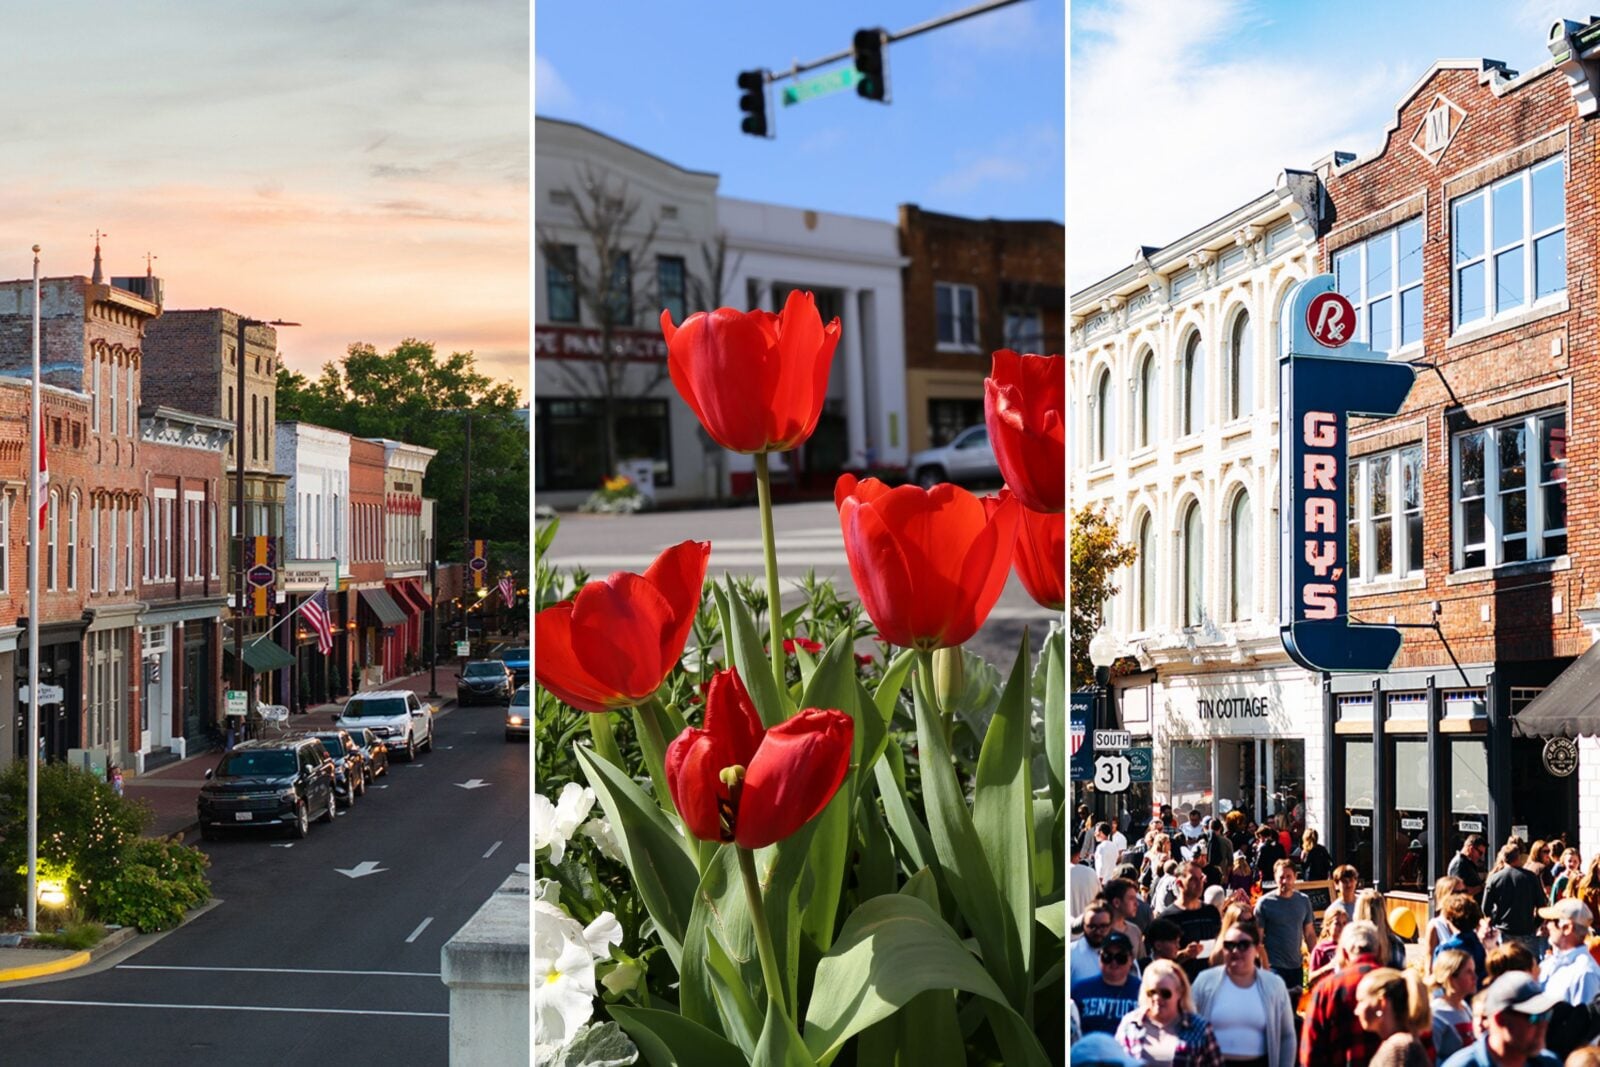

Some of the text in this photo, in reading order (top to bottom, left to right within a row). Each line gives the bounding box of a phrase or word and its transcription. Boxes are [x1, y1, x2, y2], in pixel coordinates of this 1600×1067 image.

[1303, 411, 1343, 620] GRAY'S
[1198, 697, 1268, 718] TIN COTTAGE
[1096, 733, 1129, 746] SOUTH
[1101, 763, 1122, 784] 31
